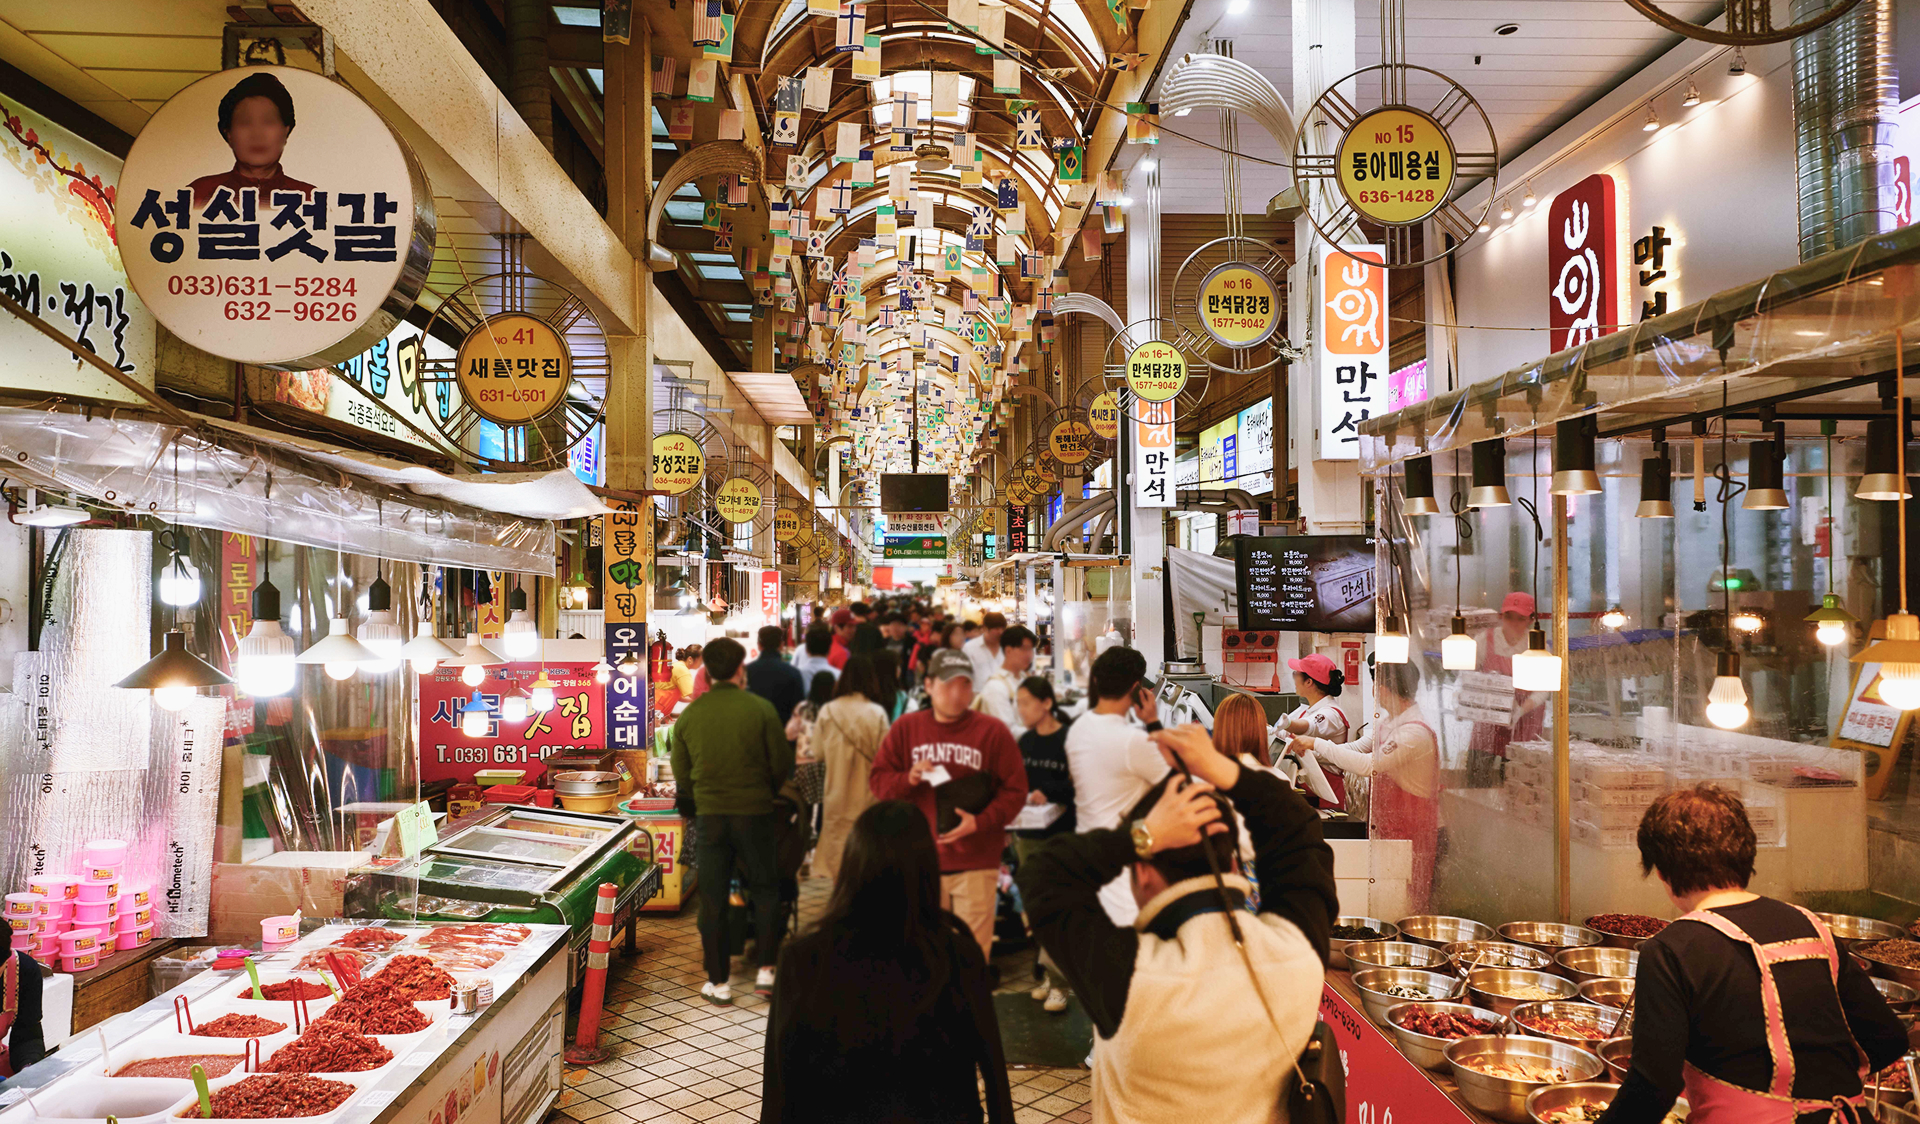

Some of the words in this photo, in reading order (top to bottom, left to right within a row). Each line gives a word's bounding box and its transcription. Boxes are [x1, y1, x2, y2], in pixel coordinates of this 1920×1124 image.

[1375, 132, 1392, 144] NO
[1396, 124, 1414, 143] 15
[1352, 150, 1440, 181] 동아미용실
[1359, 189, 1434, 203] 636-1428
[130, 187, 398, 264] 성실젓갈
[167, 275, 358, 298] 033)631-5284
[1224, 280, 1236, 289] NO
[1239, 278, 1252, 289] 16
[224, 301, 358, 323] 632-9626
[1208, 294, 1270, 314] 만석닭강정
[1212, 317, 1265, 329] 1577-9042
[494, 336, 508, 345] NO
[512, 328, 534, 344] 41
[1152, 350, 1173, 358] 16-1
[468, 358, 560, 378] 새롬맛집
[1132, 363, 1182, 378] 만석닭강정
[1135, 381, 1178, 390] 1577-9042
[479, 389, 546, 402] 631-0501
[673, 442, 684, 451] 42
[655, 477, 691, 485] 636-4693
[1144, 451, 1169, 502] 만석
[744, 496, 760, 506] 젓갈
[609, 503, 643, 617] 새롬맛집
[1341, 577, 1364, 604] 만석
[577, 679, 592, 687] 365
[911, 742, 982, 771] STANFORD
